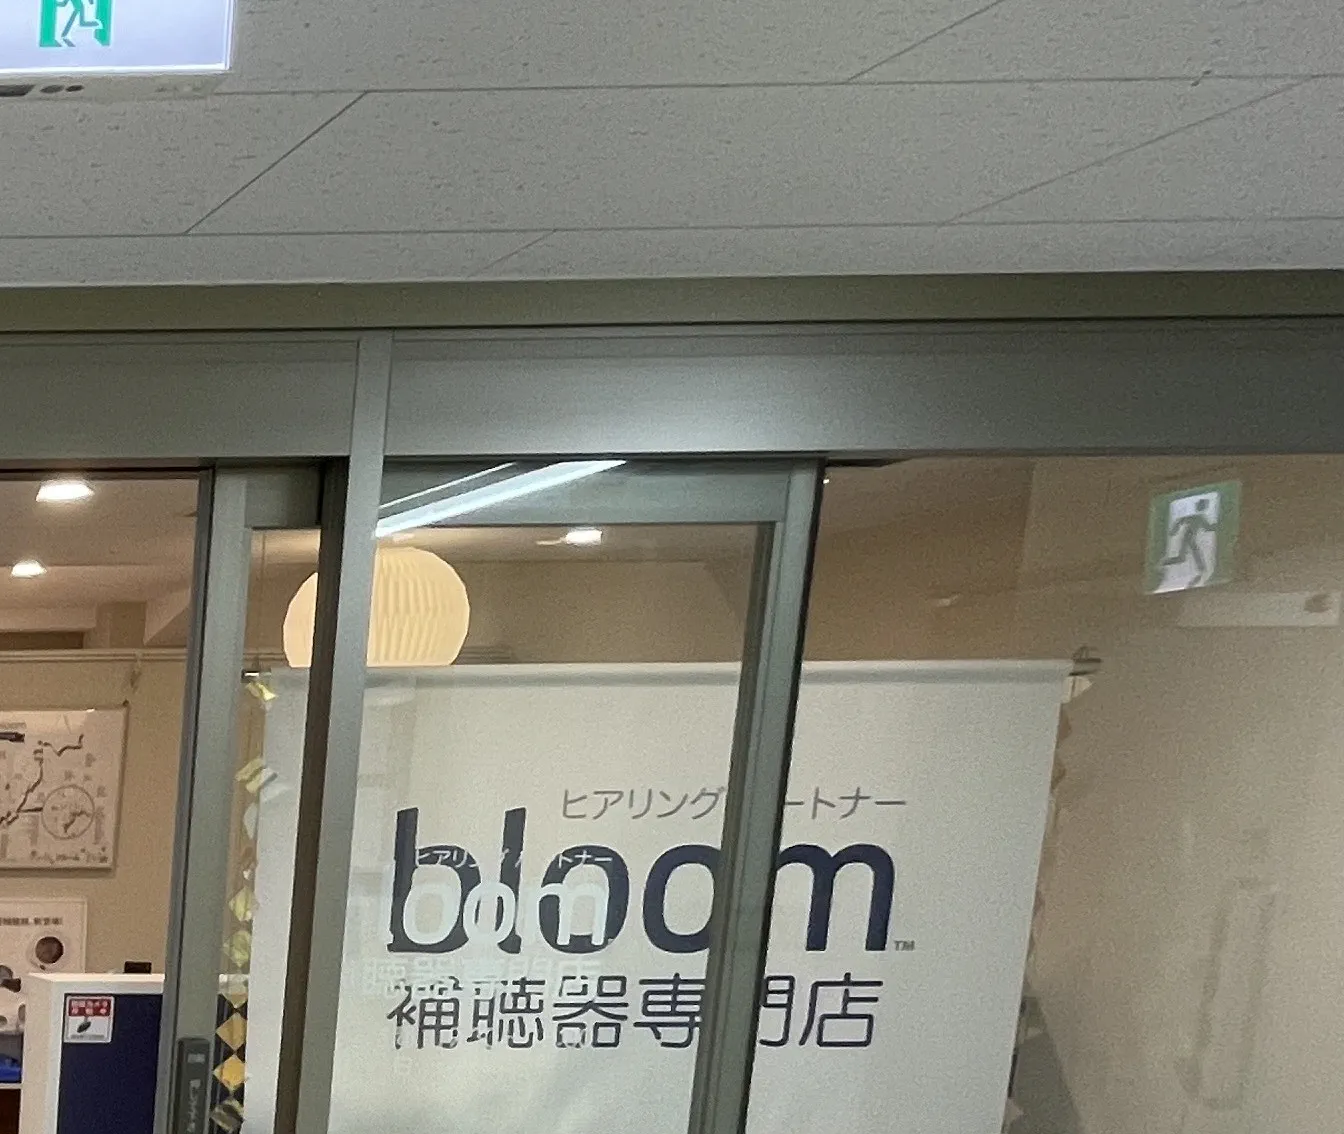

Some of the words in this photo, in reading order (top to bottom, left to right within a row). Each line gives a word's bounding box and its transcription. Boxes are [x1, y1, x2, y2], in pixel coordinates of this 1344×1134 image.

[562, 786, 724, 820] ヒアリング
[784, 786, 907, 820] ートナー
[387, 806, 896, 955] bloom
